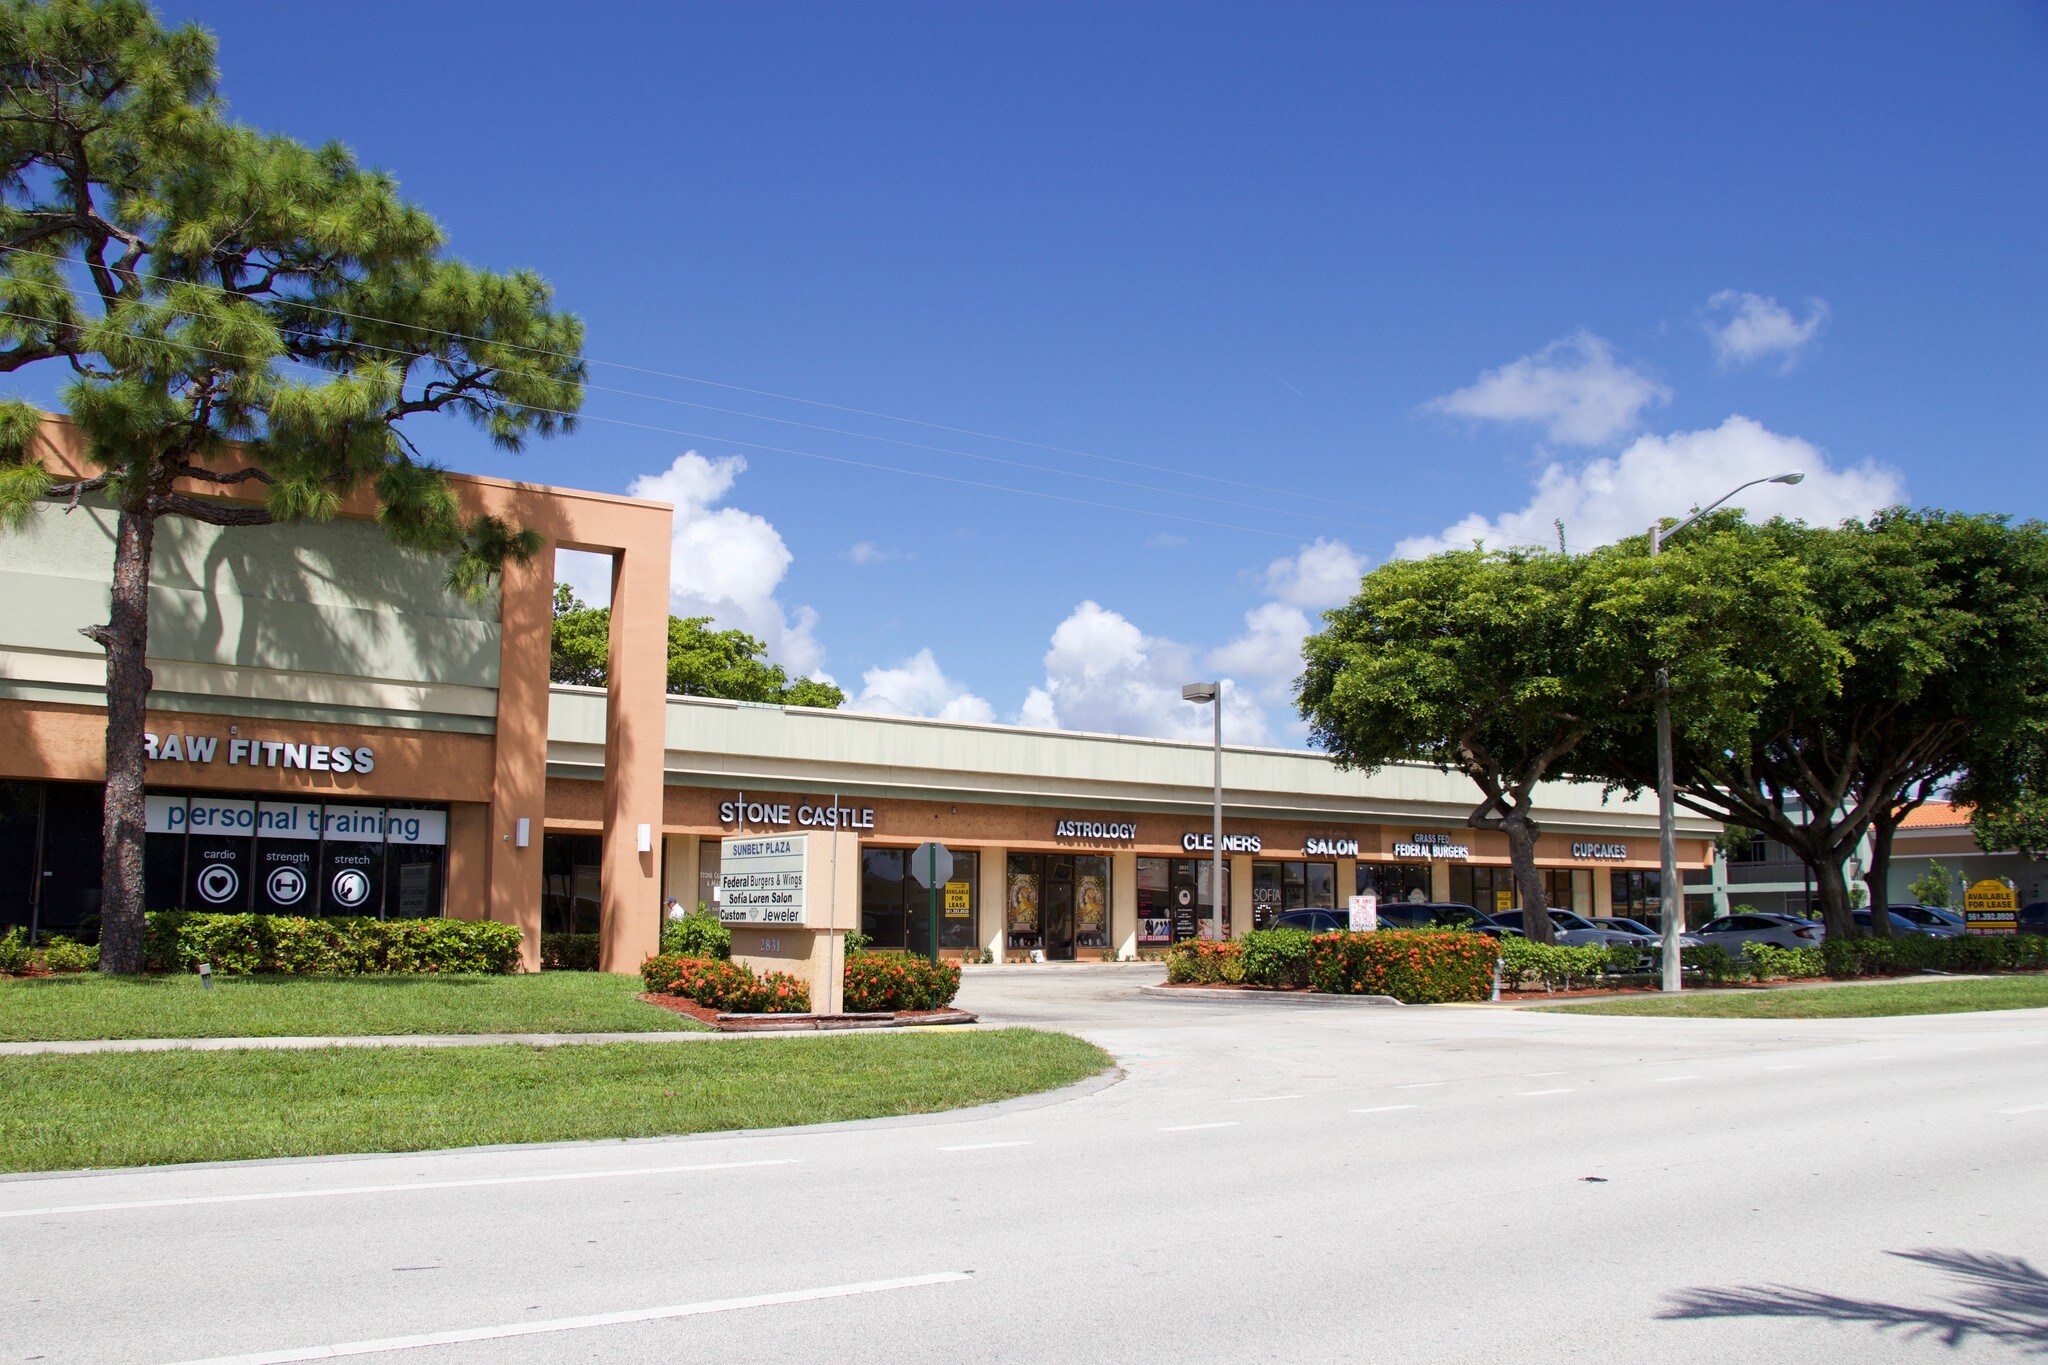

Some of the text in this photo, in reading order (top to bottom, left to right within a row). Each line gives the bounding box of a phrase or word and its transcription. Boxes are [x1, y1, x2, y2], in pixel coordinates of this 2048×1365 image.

[144, 733, 374, 774] RAW FITNESS
[720, 801, 875, 829] STONE CASTLE
[167, 805, 420, 841] personal training
[1056, 820, 1137, 839] ASTROLOGY
[1183, 833, 1261, 852] CLENERS
[1414, 833, 1450, 844] GRASS FED
[733, 841, 791, 856] SUNBELT PLAZA
[1306, 838, 1358, 855] SALON
[1394, 843, 1469, 858] FEDERAL BURGERS
[1572, 843, 1626, 858] CUPCAKES
[203, 850, 237, 860] cardio
[266, 852, 311, 865] strength
[334, 855, 370, 866] stretch
[723, 873, 803, 889] Federal Burgers & Wings
[748, 893, 770, 904] Loren
[771, 892, 793, 904] Salon
[720, 909, 747, 920] Custom
[763, 908, 799, 922] Jeweler
[760, 939, 781, 952] 2831
